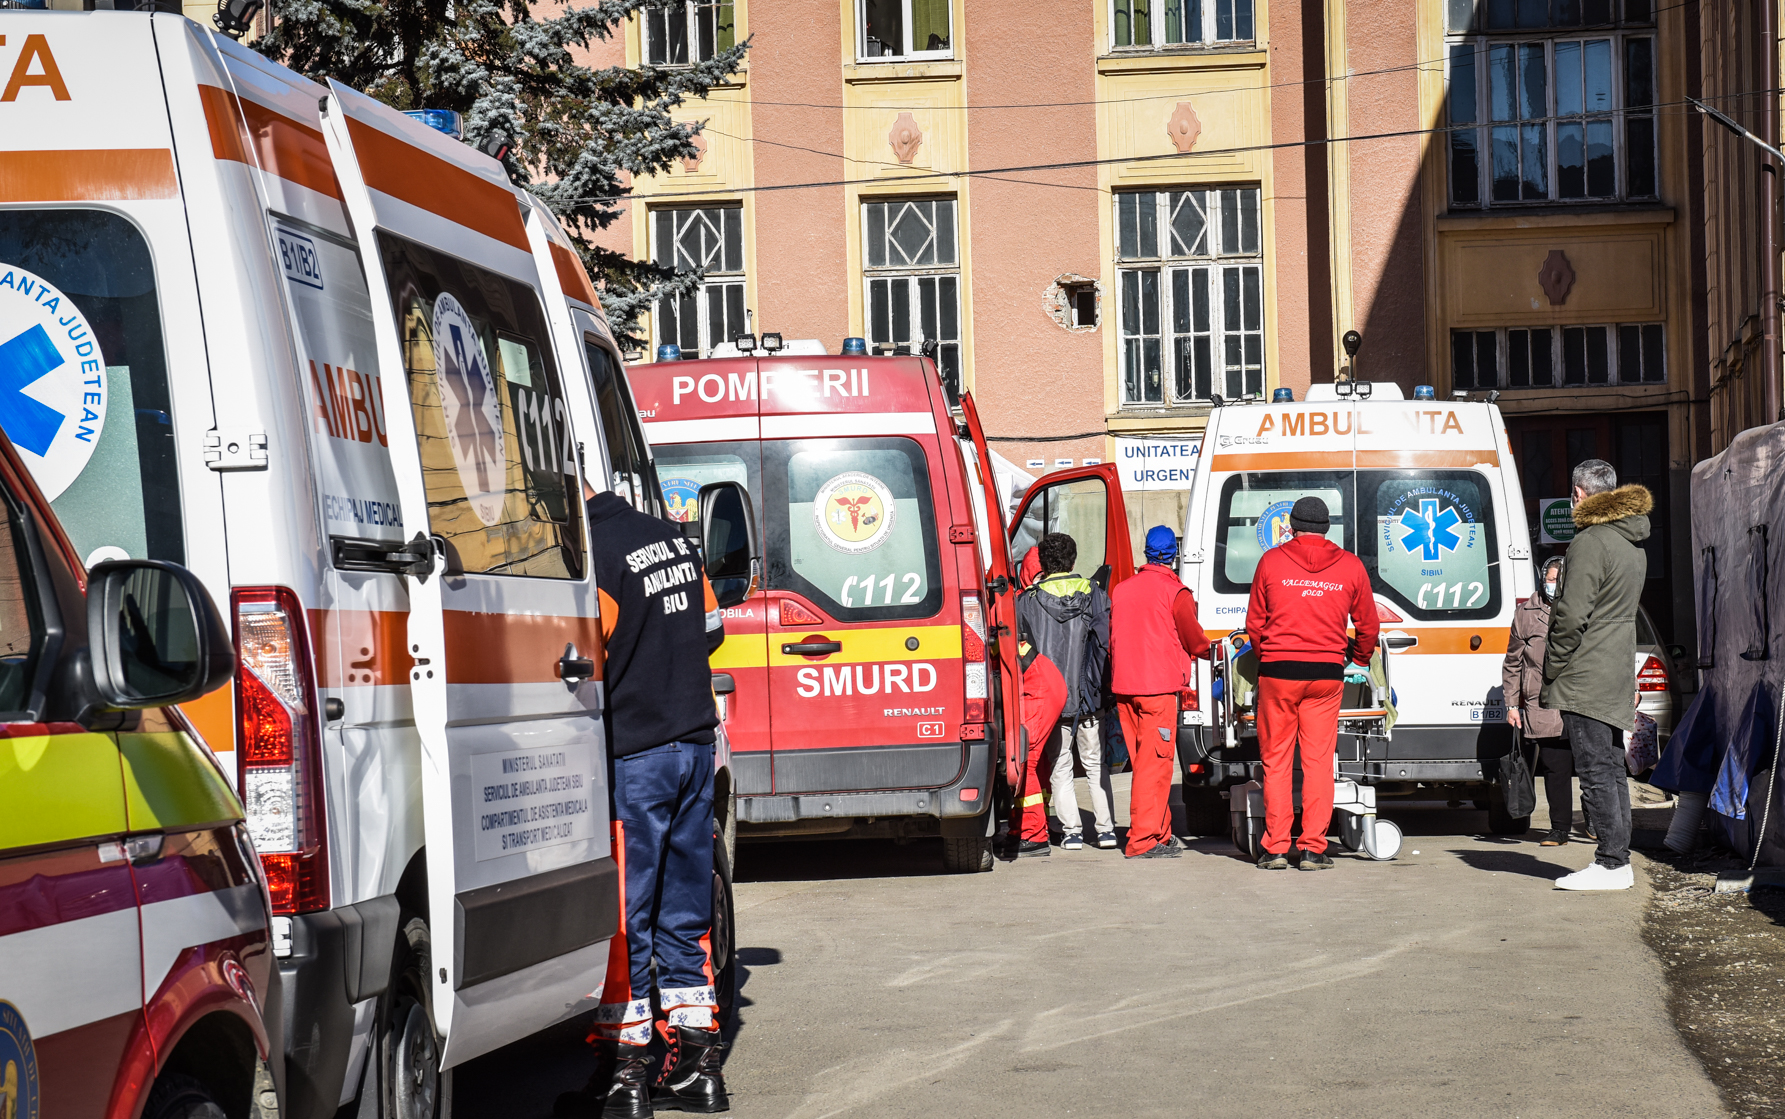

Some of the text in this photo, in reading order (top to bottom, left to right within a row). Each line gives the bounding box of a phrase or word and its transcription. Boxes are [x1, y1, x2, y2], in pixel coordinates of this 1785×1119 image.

[279, 238, 320, 281] B1/B2
[58, 315, 102, 443] JUDETEAN
[672, 368, 870, 405] POMPERII
[1256, 411, 1465, 437] AMBULNTA
[1124, 444, 1200, 459] UNITATEA
[837, 485, 869, 496] SMURD
[326, 494, 404, 528] ECHIPAJ MEDICAL
[1383, 486, 1476, 553] SERVICIUL DE AMBULANTA JUDETEAN
[672, 537, 691, 556] DE
[1281, 578, 1344, 592] VALLEMAGGIA
[796, 662, 938, 698] SMURD
[883, 706, 946, 718] RENAULT
[1451, 698, 1503, 707] RENAULT
[1472, 710, 1501, 719] B1/B2
[501, 751, 566, 775] MINISTERUL SANATATII
[483, 773, 584, 803] SERVICIUL DE AMBULANTA JUDETEAN SIBIU
[481, 798, 589, 832] COMPARTIMENTUL DE ASISTENTA MEDICALA
[508, 826, 541, 849] TRANSPORT
[540, 821, 574, 842] MEDICALIZAT
